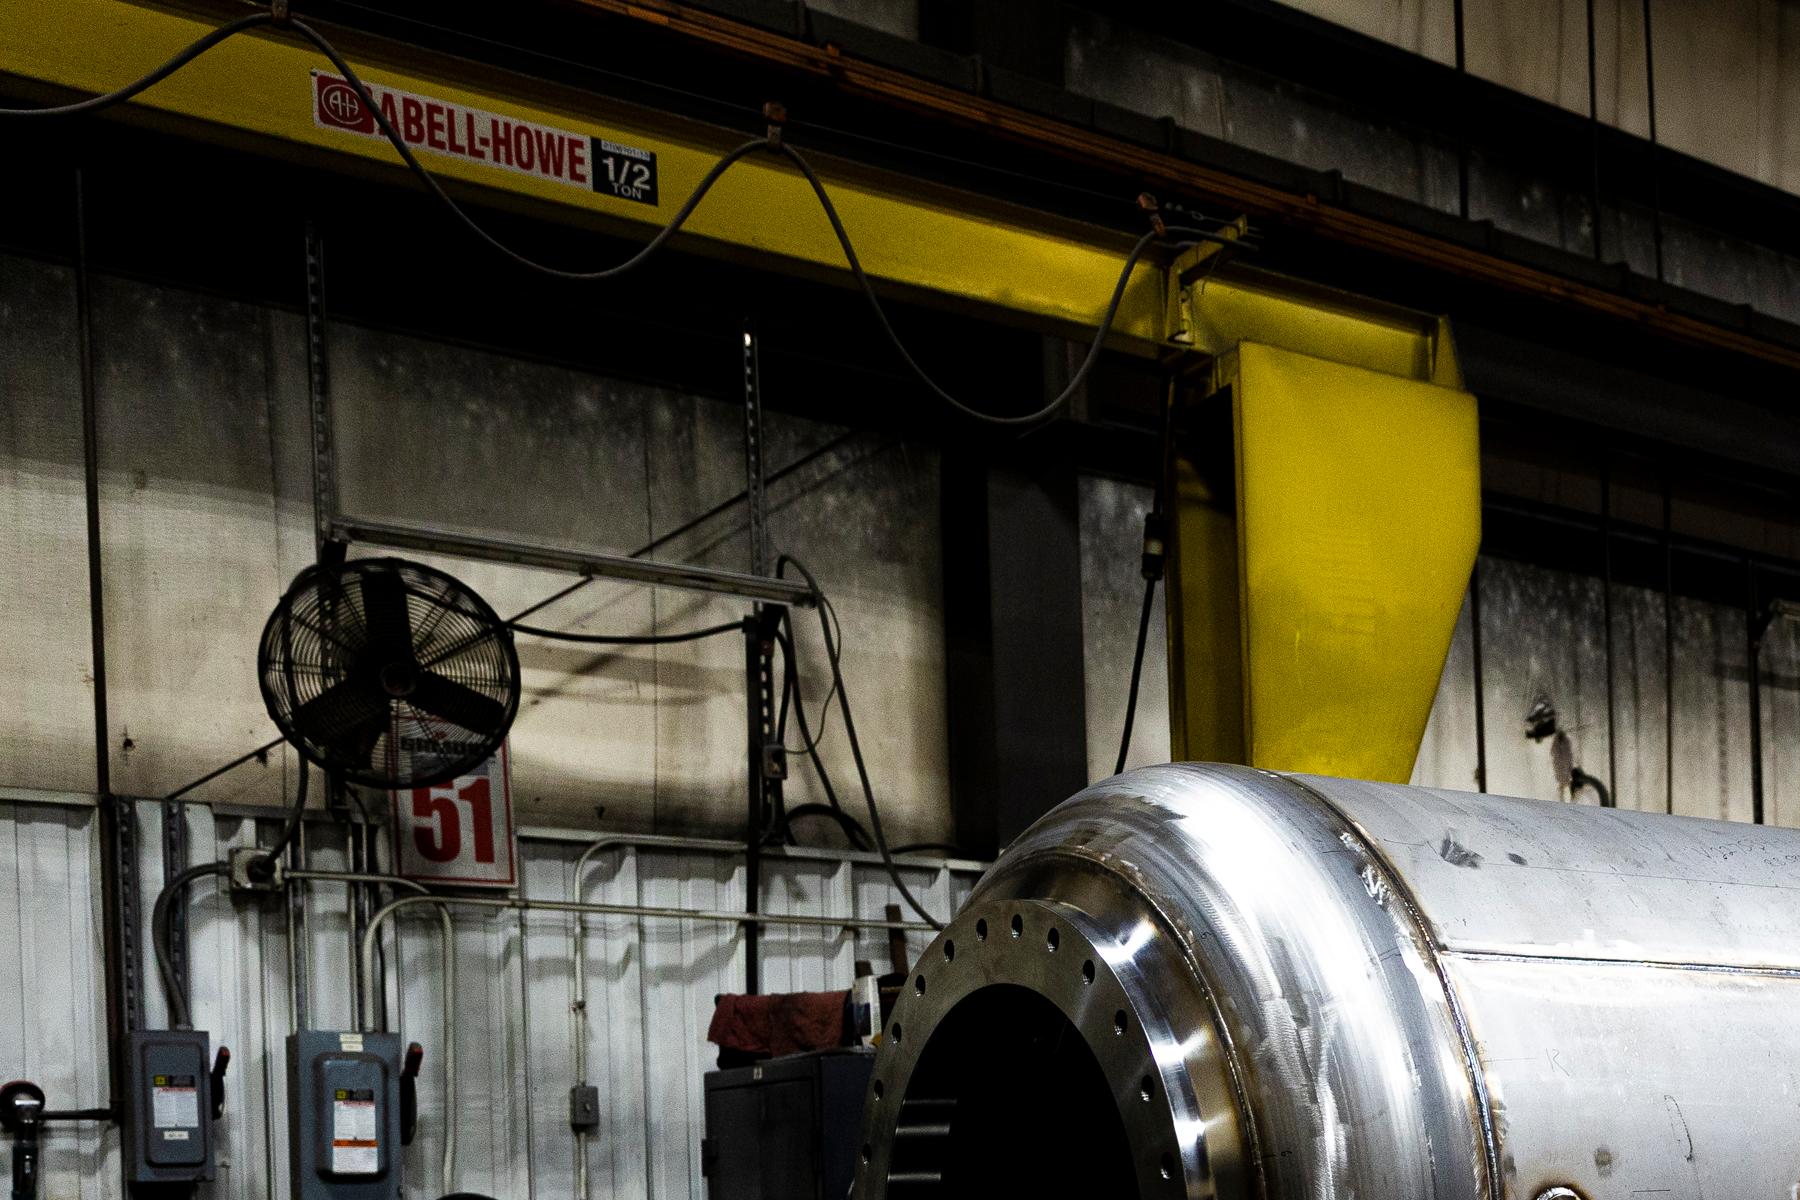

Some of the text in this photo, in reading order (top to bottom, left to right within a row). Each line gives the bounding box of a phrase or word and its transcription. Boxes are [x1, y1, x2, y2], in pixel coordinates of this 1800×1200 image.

[379, 92, 587, 184] ABELL-HOWE
[602, 154, 651, 191] 1/2
[611, 182, 643, 200] TON
[413, 776, 494, 863] 51
